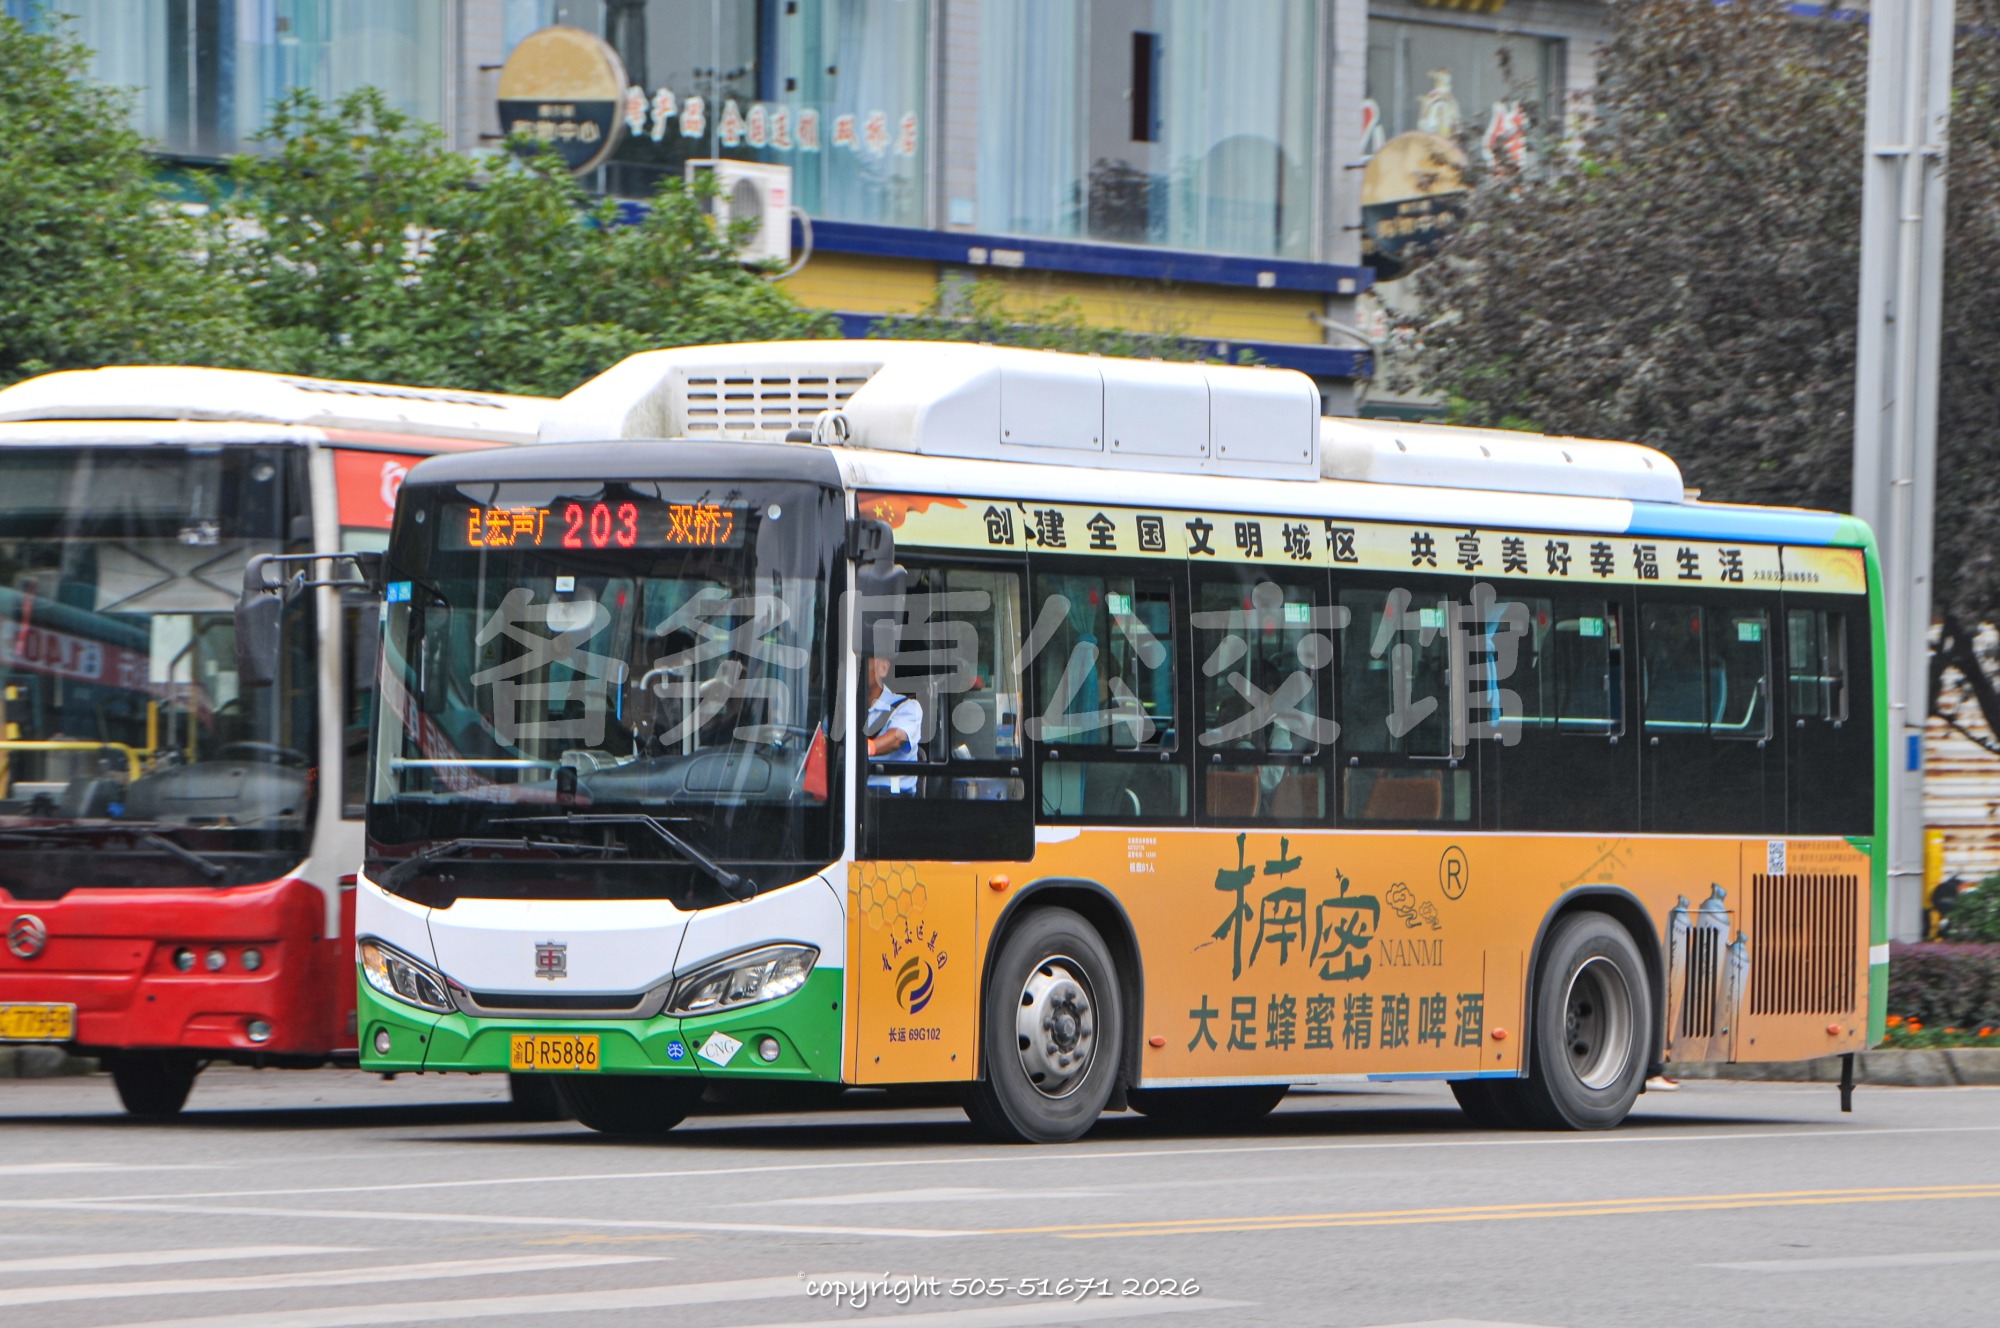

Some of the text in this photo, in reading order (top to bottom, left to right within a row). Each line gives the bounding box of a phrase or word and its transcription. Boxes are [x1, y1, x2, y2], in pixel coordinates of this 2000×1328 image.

[562, 502, 638, 549] 203
[983, 505, 1744, 583] 创建全国文明城区 共享美好幸福生活
[1379, 939, 1444, 967] NANMI
[888, 1027, 941, 1042] 长运 69G102
[1187, 992, 1484, 1052] 大足蜂蜜精酿啤酒
[705, 1039, 734, 1058] CNG
